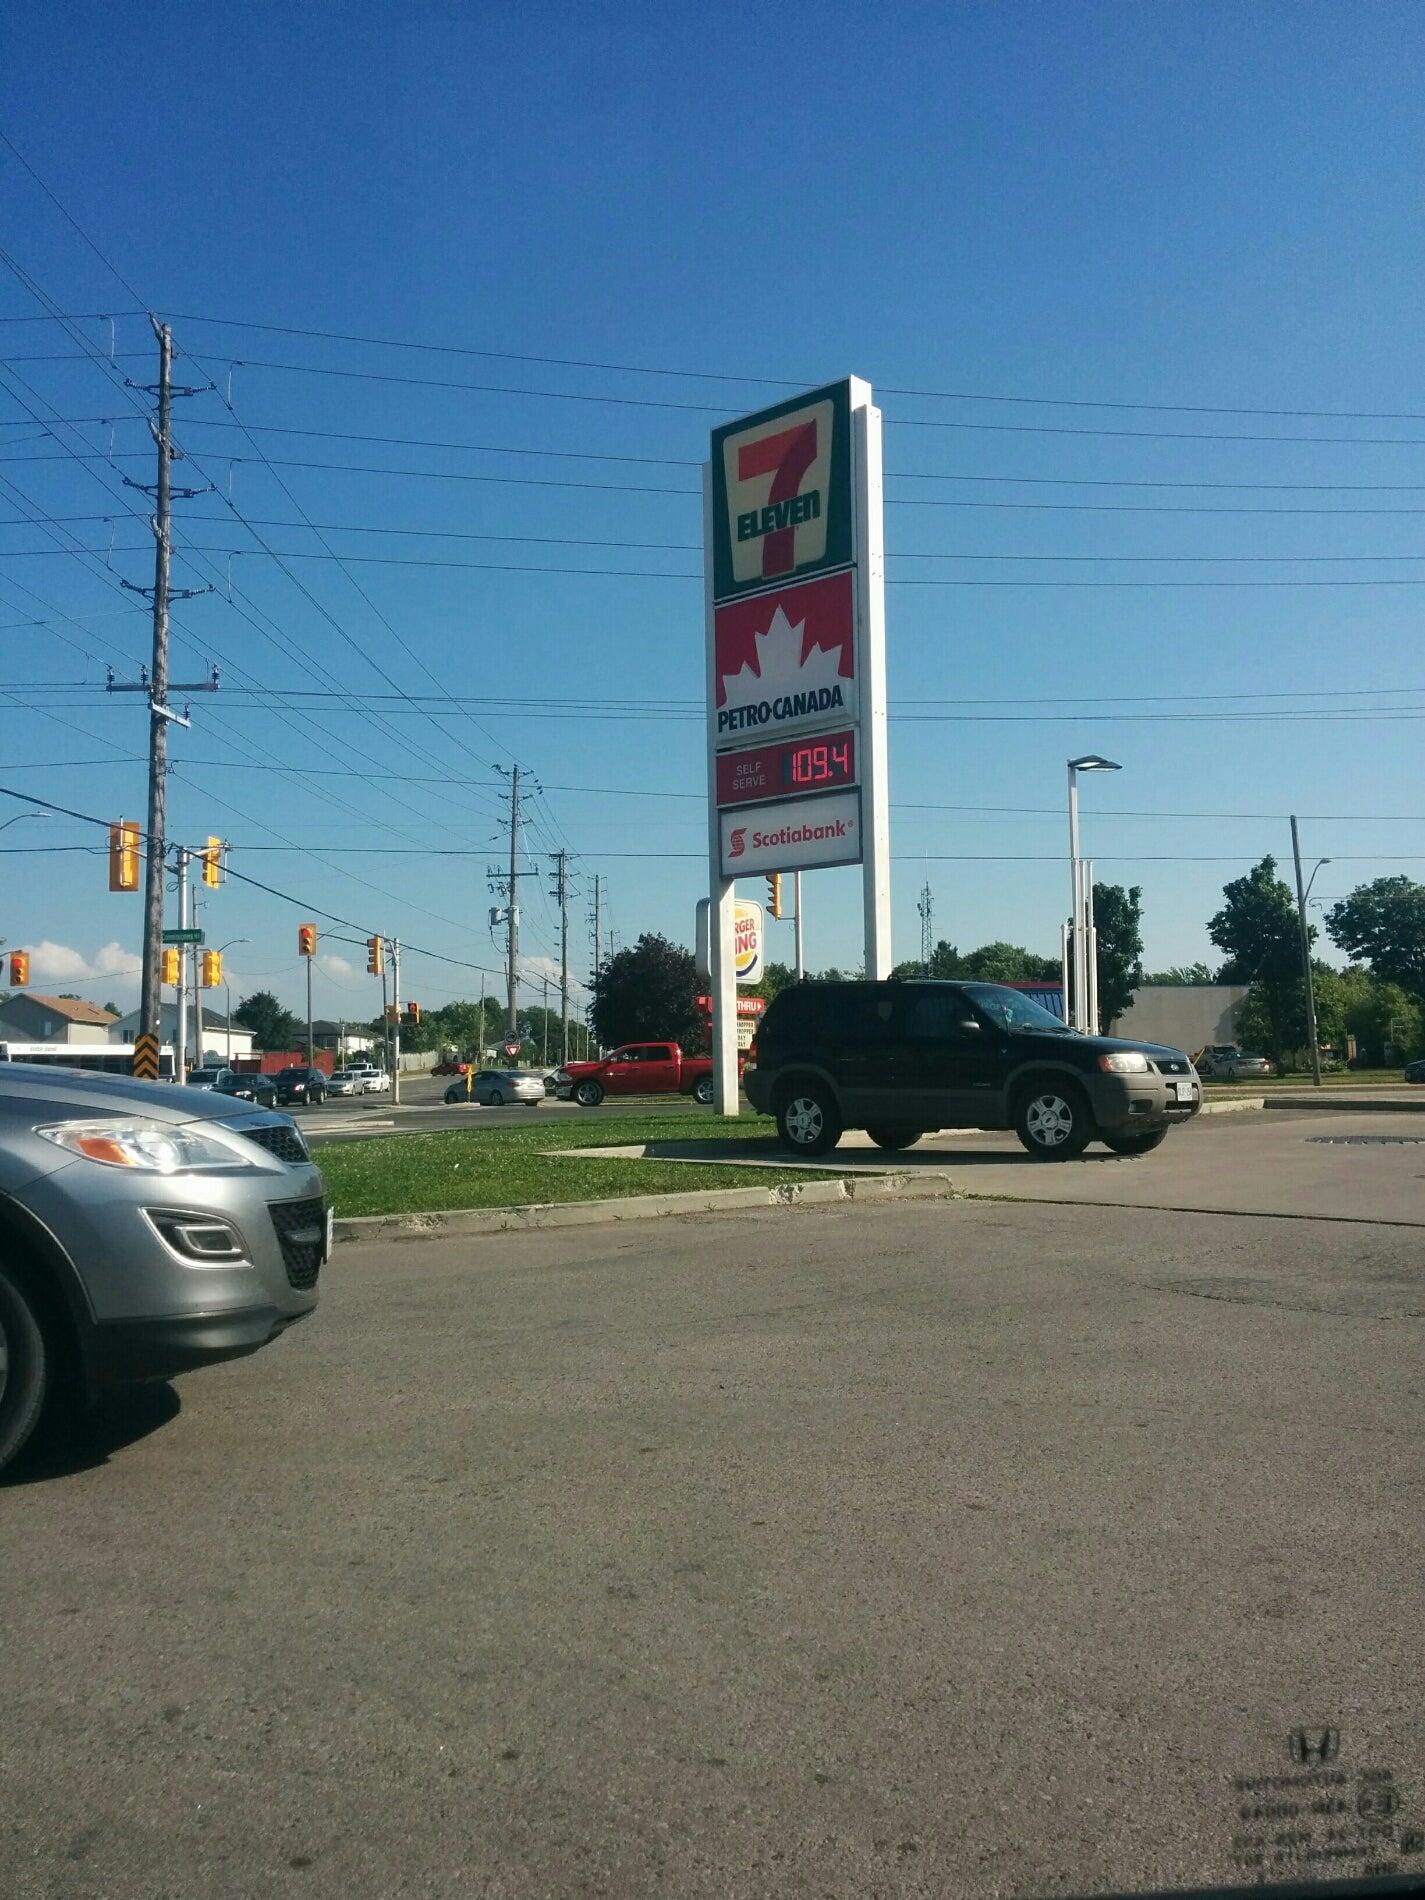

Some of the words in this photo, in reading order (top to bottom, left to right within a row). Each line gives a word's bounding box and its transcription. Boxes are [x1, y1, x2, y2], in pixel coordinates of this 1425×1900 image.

[738, 417, 818, 578] 7
[736, 761, 762, 776] SELF
[792, 743, 849, 782] 109.4
[732, 774, 766, 790] SERVE
[752, 819, 846, 849] Scotiabank
[735, 918, 755, 934] RGER
[735, 932, 757, 955] ING
